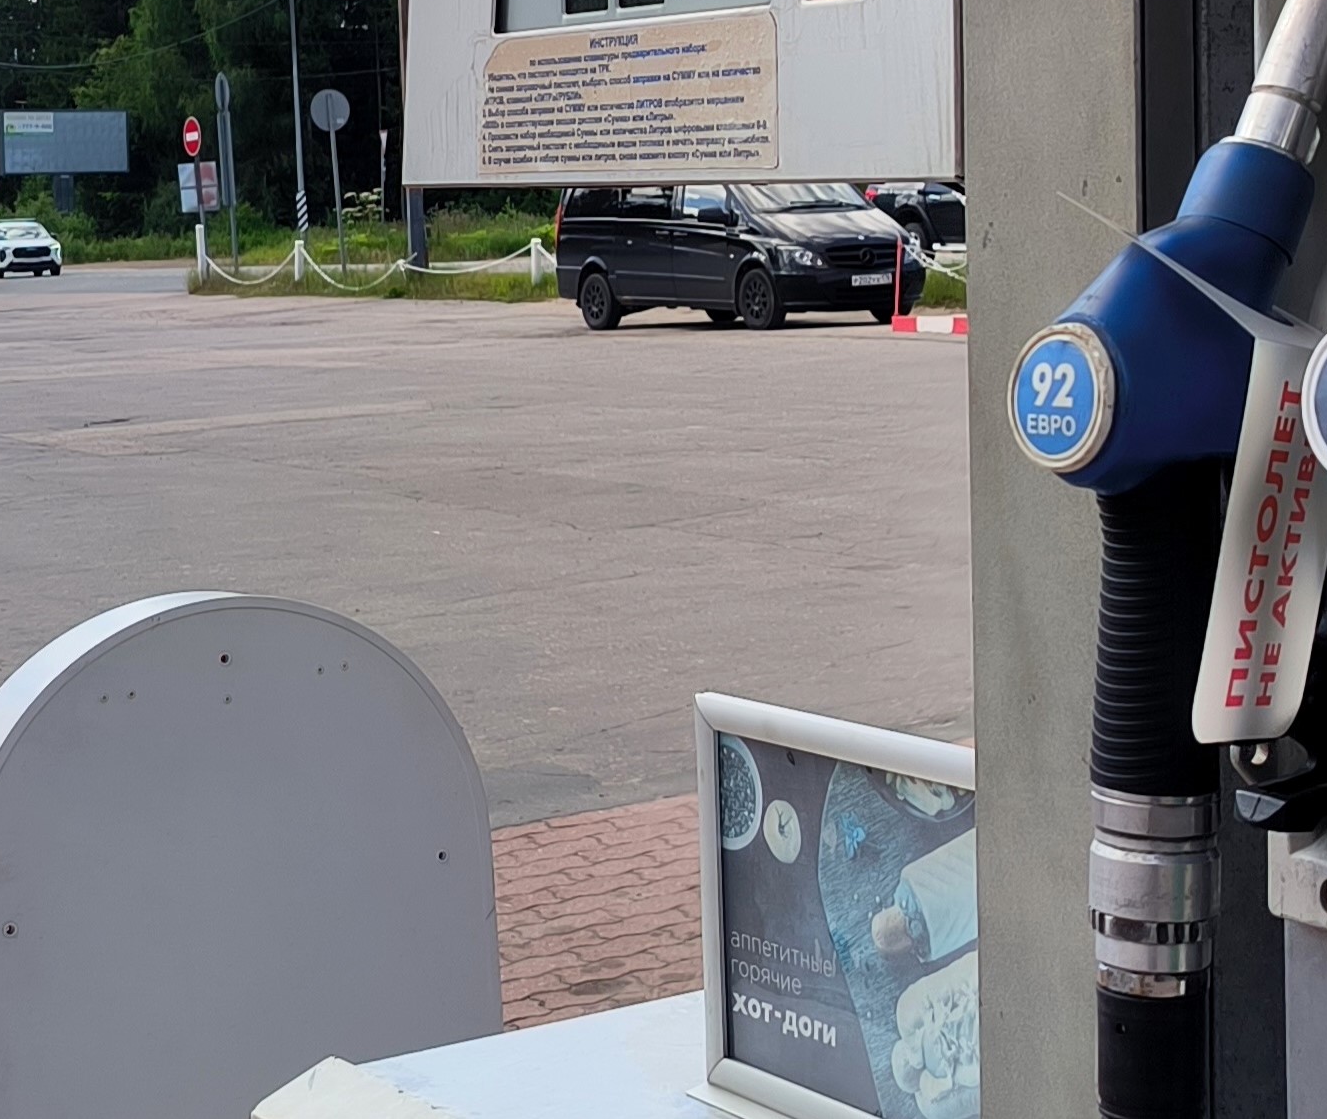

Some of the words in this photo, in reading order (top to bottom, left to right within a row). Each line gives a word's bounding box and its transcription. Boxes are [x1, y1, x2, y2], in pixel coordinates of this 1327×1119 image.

[589, 33, 639, 49] ИНСТРУКЦИЯ
[1030, 362, 1076, 409] 92
[1026, 412, 1077, 438] ЕВРО
[1225, 380, 1302, 708] ПИСТОЛЕТ
[1255, 642, 1282, 708] НЕ
[1272, 439, 1318, 629] АКТИВ
[730, 930, 834, 978] аппетитные
[731, 958, 803, 996] горячие
